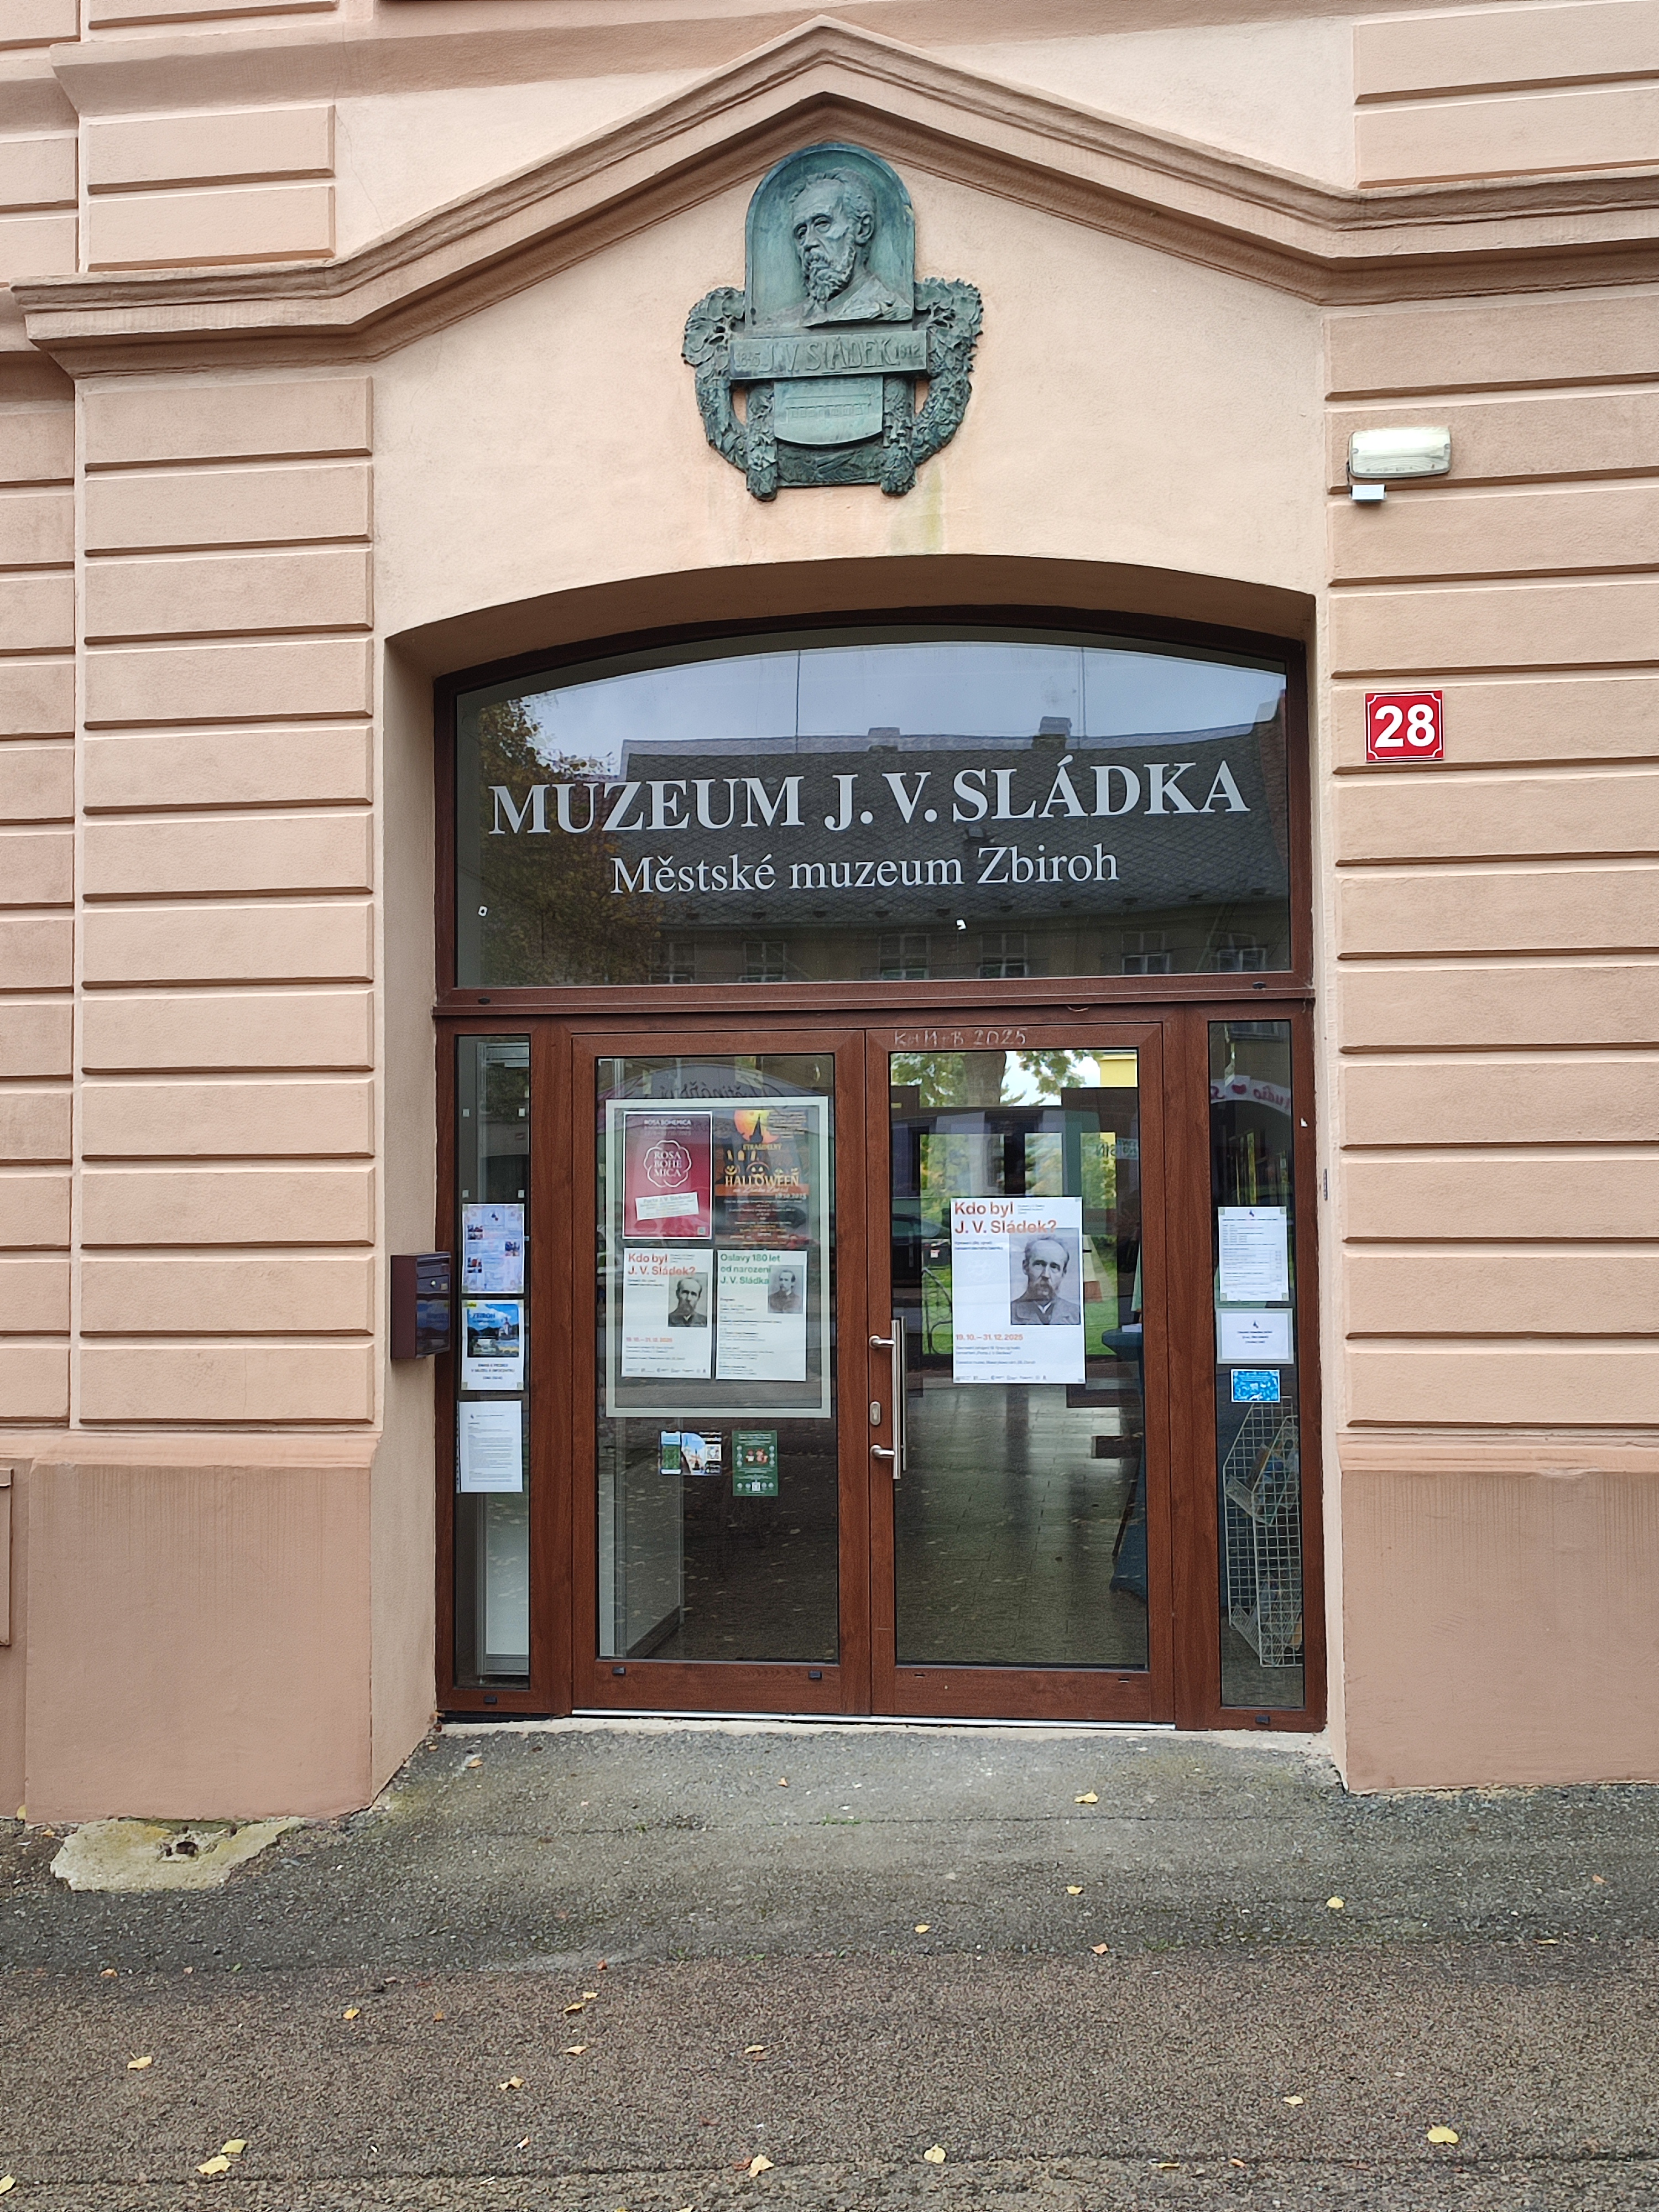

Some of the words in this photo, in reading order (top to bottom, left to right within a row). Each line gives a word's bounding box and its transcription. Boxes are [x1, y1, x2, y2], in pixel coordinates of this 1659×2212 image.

[1374, 703, 1436, 748] 28
[488, 775, 805, 835] MUZEUM
[824, 774, 874, 832] J.
[882, 771, 938, 825] V.
[952, 754, 1251, 823] SLÁDKA
[609, 853, 776, 894] Městské
[788, 856, 964, 890] muzeum
[977, 843, 1120, 885] Zbiroh
[973, 1027, 1029, 1045] 2025
[654, 1151, 682, 1160] ROSA
[654, 1160, 682, 1168] BOHE
[654, 1168, 682, 1177] MICA
[724, 1175, 800, 1187] HALLOWEEN
[954, 1201, 987, 1215] Kdo
[990, 1201, 1014, 1218] byl
[954, 1220, 969, 1234] J.
[972, 1220, 987, 1234] V.
[990, 1219, 1057, 1234] Sládek?
[628, 1253, 650, 1263] Kdo
[652, 1253, 668, 1265] byl
[720, 1253, 750, 1264] Oslavy
[752, 1254, 768, 1262] 180
[769, 1254, 781, 1262] let
[628, 1266, 638, 1275] J.
[640, 1266, 650, 1275] V.
[651, 1265, 696, 1276] Sládek?
[720, 1276, 728, 1284] J.
[729, 1276, 738, 1284] V.
[739, 1276, 770, 1285] Sládka
